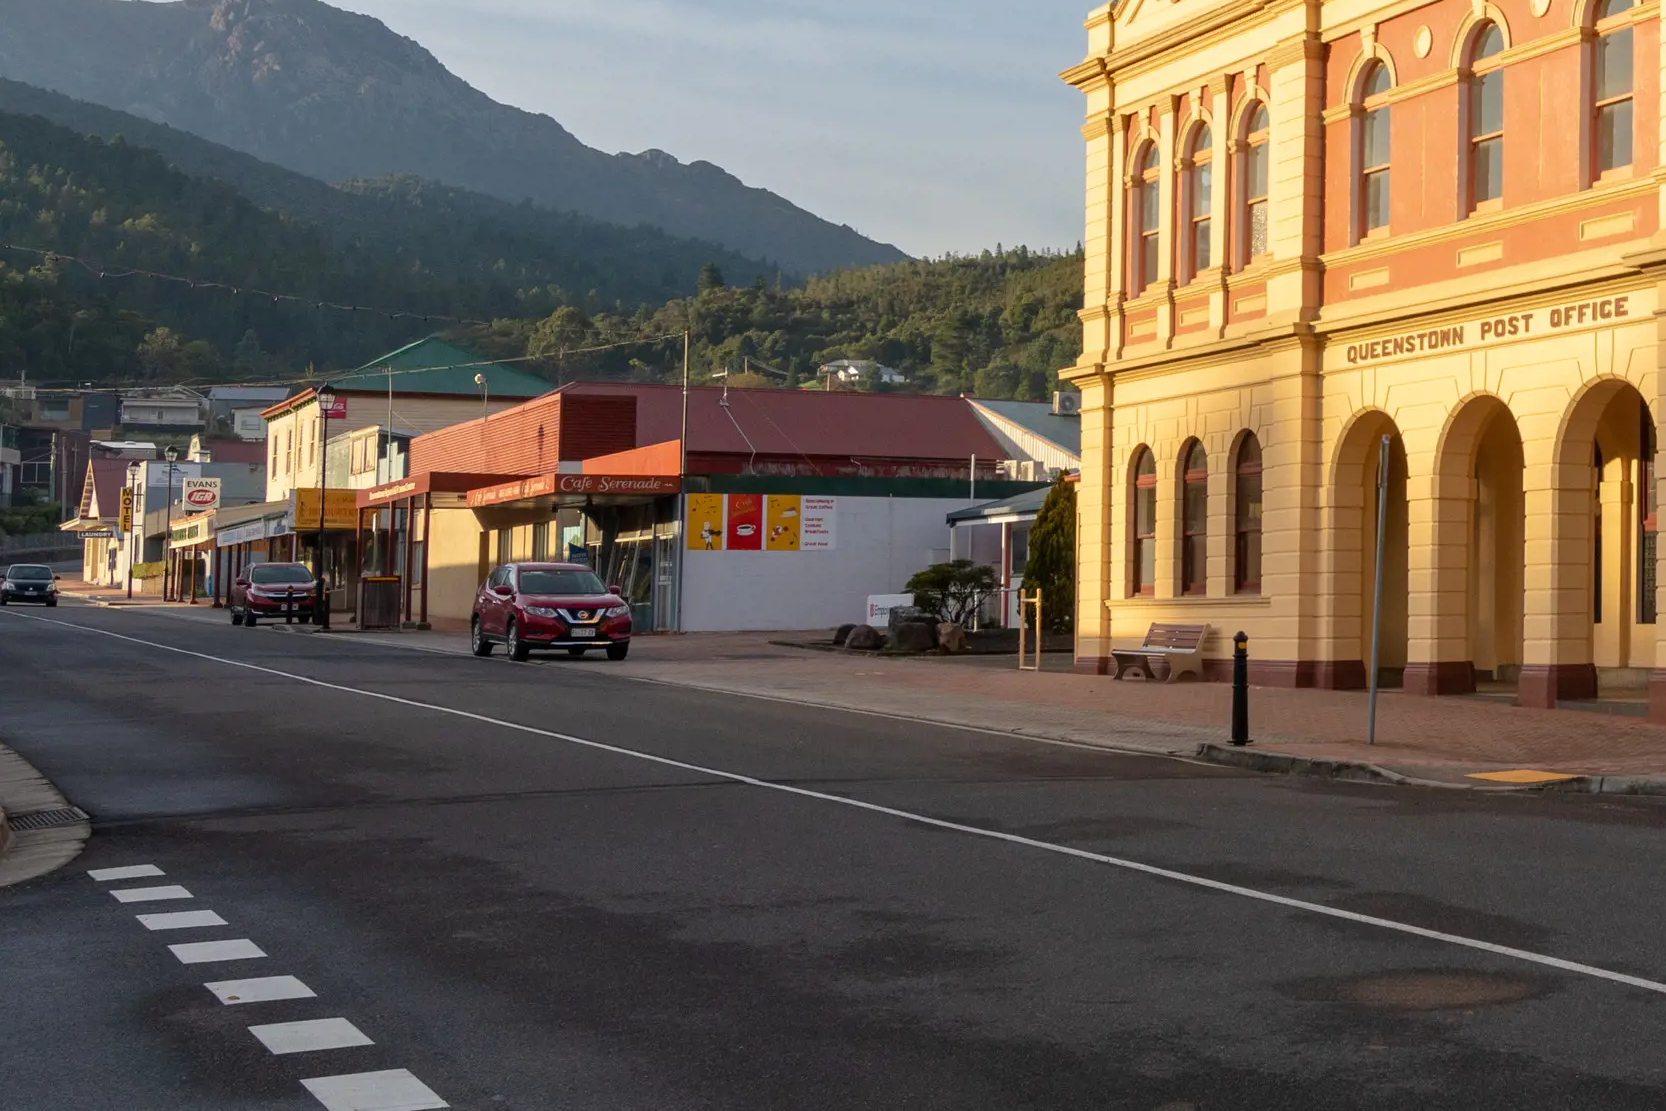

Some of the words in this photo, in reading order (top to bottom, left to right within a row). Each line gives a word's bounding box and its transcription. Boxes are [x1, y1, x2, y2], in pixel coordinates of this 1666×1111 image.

[1346, 325, 1465, 364] QUEENSTOWN
[1480, 313, 1534, 341] POST
[1549, 296, 1629, 328] OFFICE
[598, 476, 661, 491] Serenade
[122, 488, 132, 532] MOTEL
